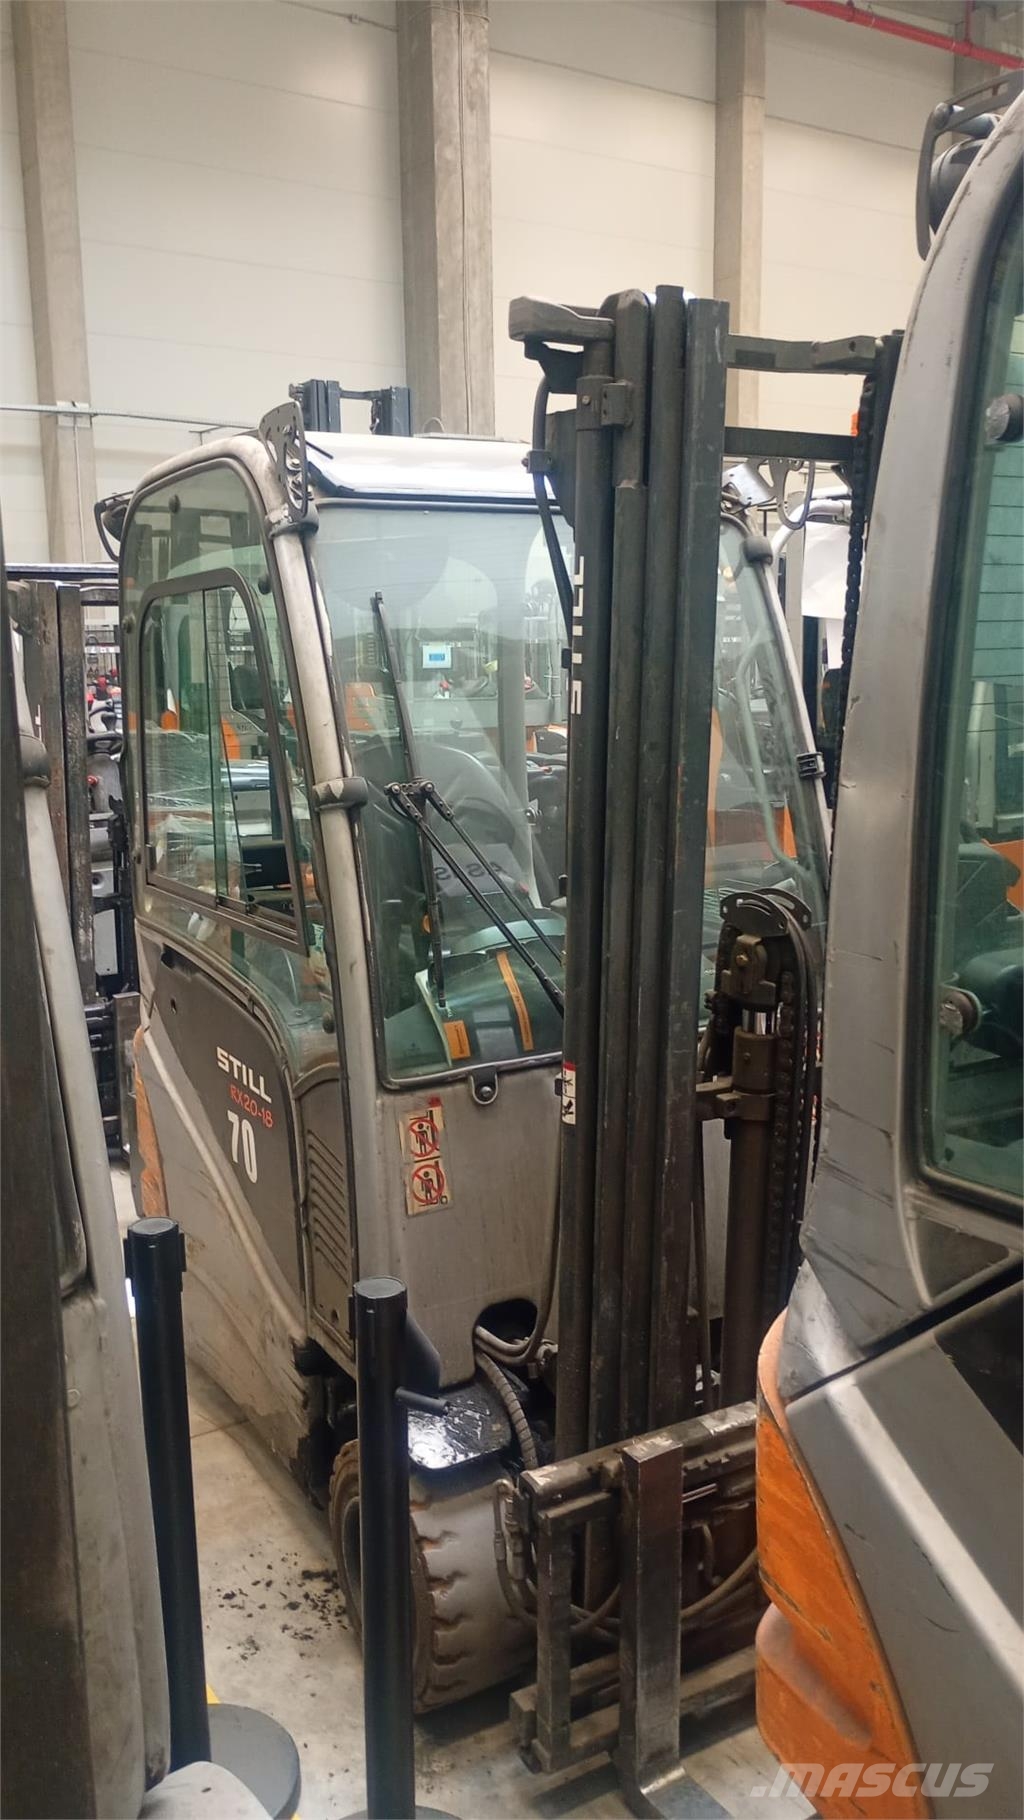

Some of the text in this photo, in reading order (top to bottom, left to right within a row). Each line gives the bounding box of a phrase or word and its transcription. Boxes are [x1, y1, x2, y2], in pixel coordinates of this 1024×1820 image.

[217, 1047, 272, 1103] STILL
[230, 1085, 273, 1127] RX20-18
[227, 1110, 257, 1183] 70
